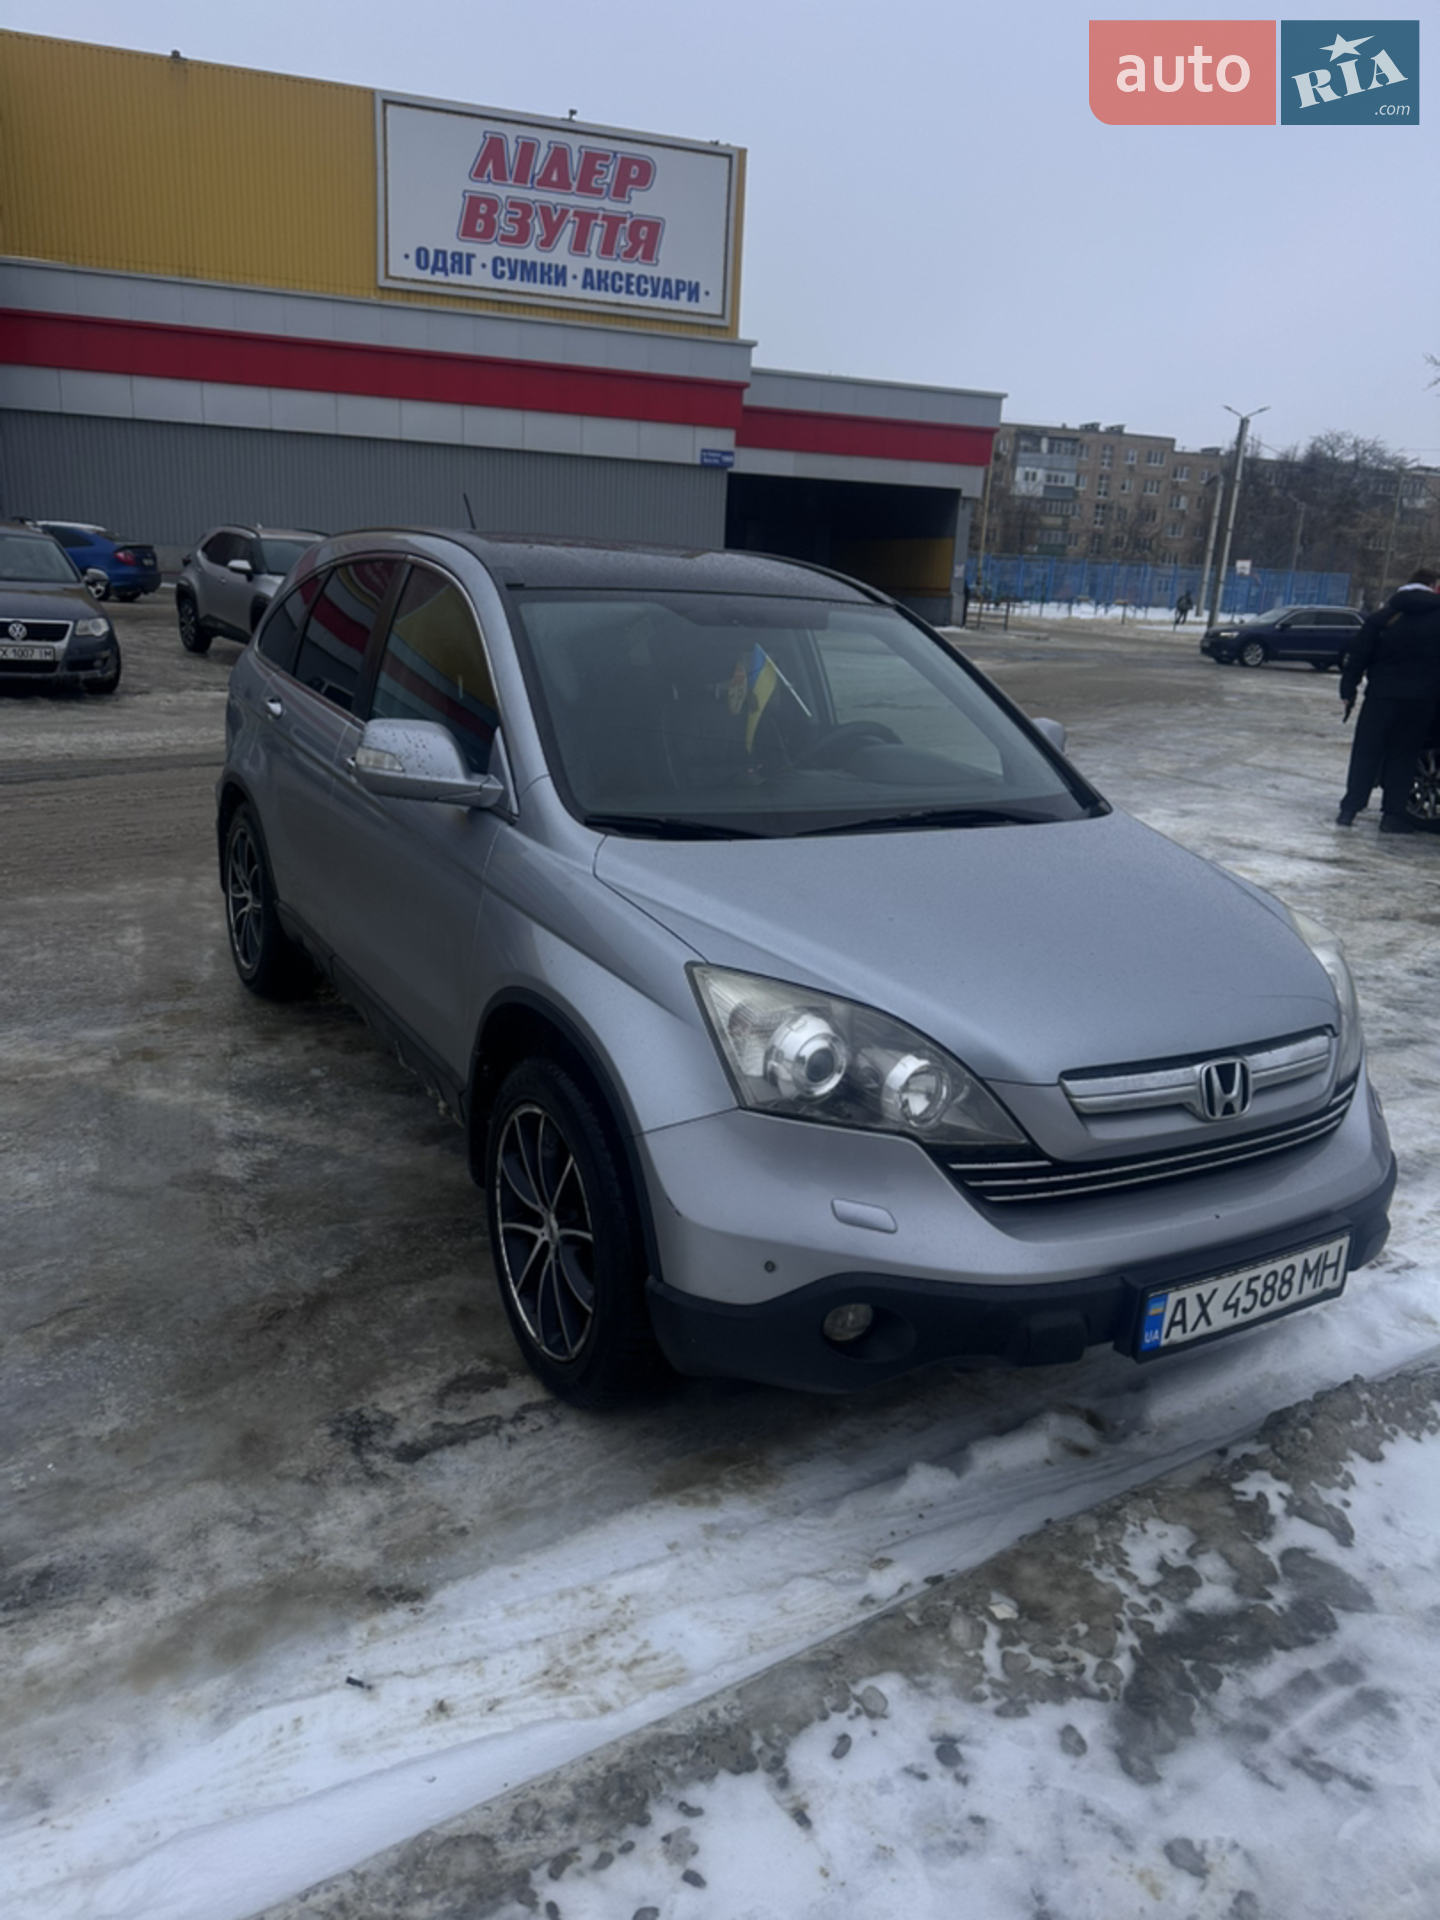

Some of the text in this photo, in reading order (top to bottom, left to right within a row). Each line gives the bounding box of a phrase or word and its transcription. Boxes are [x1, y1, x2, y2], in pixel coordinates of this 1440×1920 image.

[469, 130, 656, 202] ЛІДЕР
[456, 190, 665, 266] ВЗУТТЯ
[415, 246, 700, 303] ОДЯГ СУМКИ АКСЕСУАРИ
[1164, 1245, 1344, 1340] AX 4588 MH
[1144, 1329, 1160, 1343] UA
